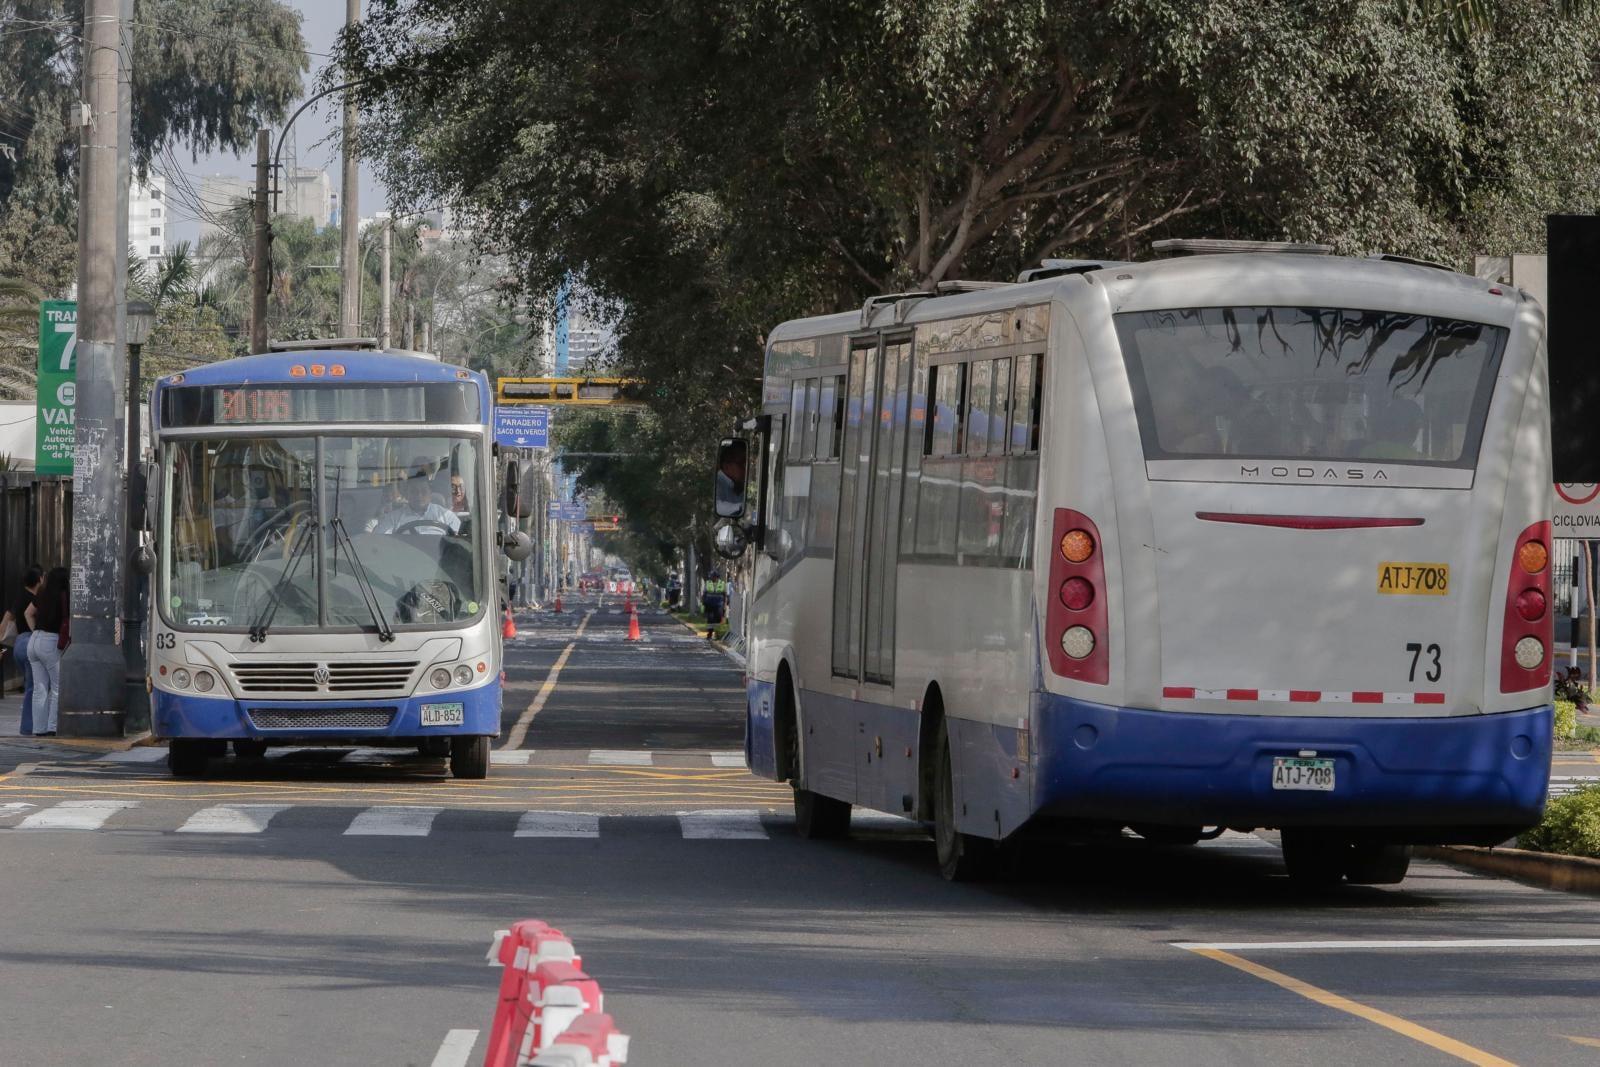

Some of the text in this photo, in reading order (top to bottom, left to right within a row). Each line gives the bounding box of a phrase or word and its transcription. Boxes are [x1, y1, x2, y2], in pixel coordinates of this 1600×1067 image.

[54, 323, 77, 370] 7
[501, 418, 542, 427] PARADERO
[1241, 466, 1388, 480] MODASA
[1553, 515, 1600, 527] CICLOVIA
[1380, 566, 1447, 591] ATJ-708
[156, 632, 176, 650] 83
[1406, 643, 1442, 683] 73
[423, 709, 461, 722] ALD-852
[1275, 766, 1332, 785] ATJ-708
